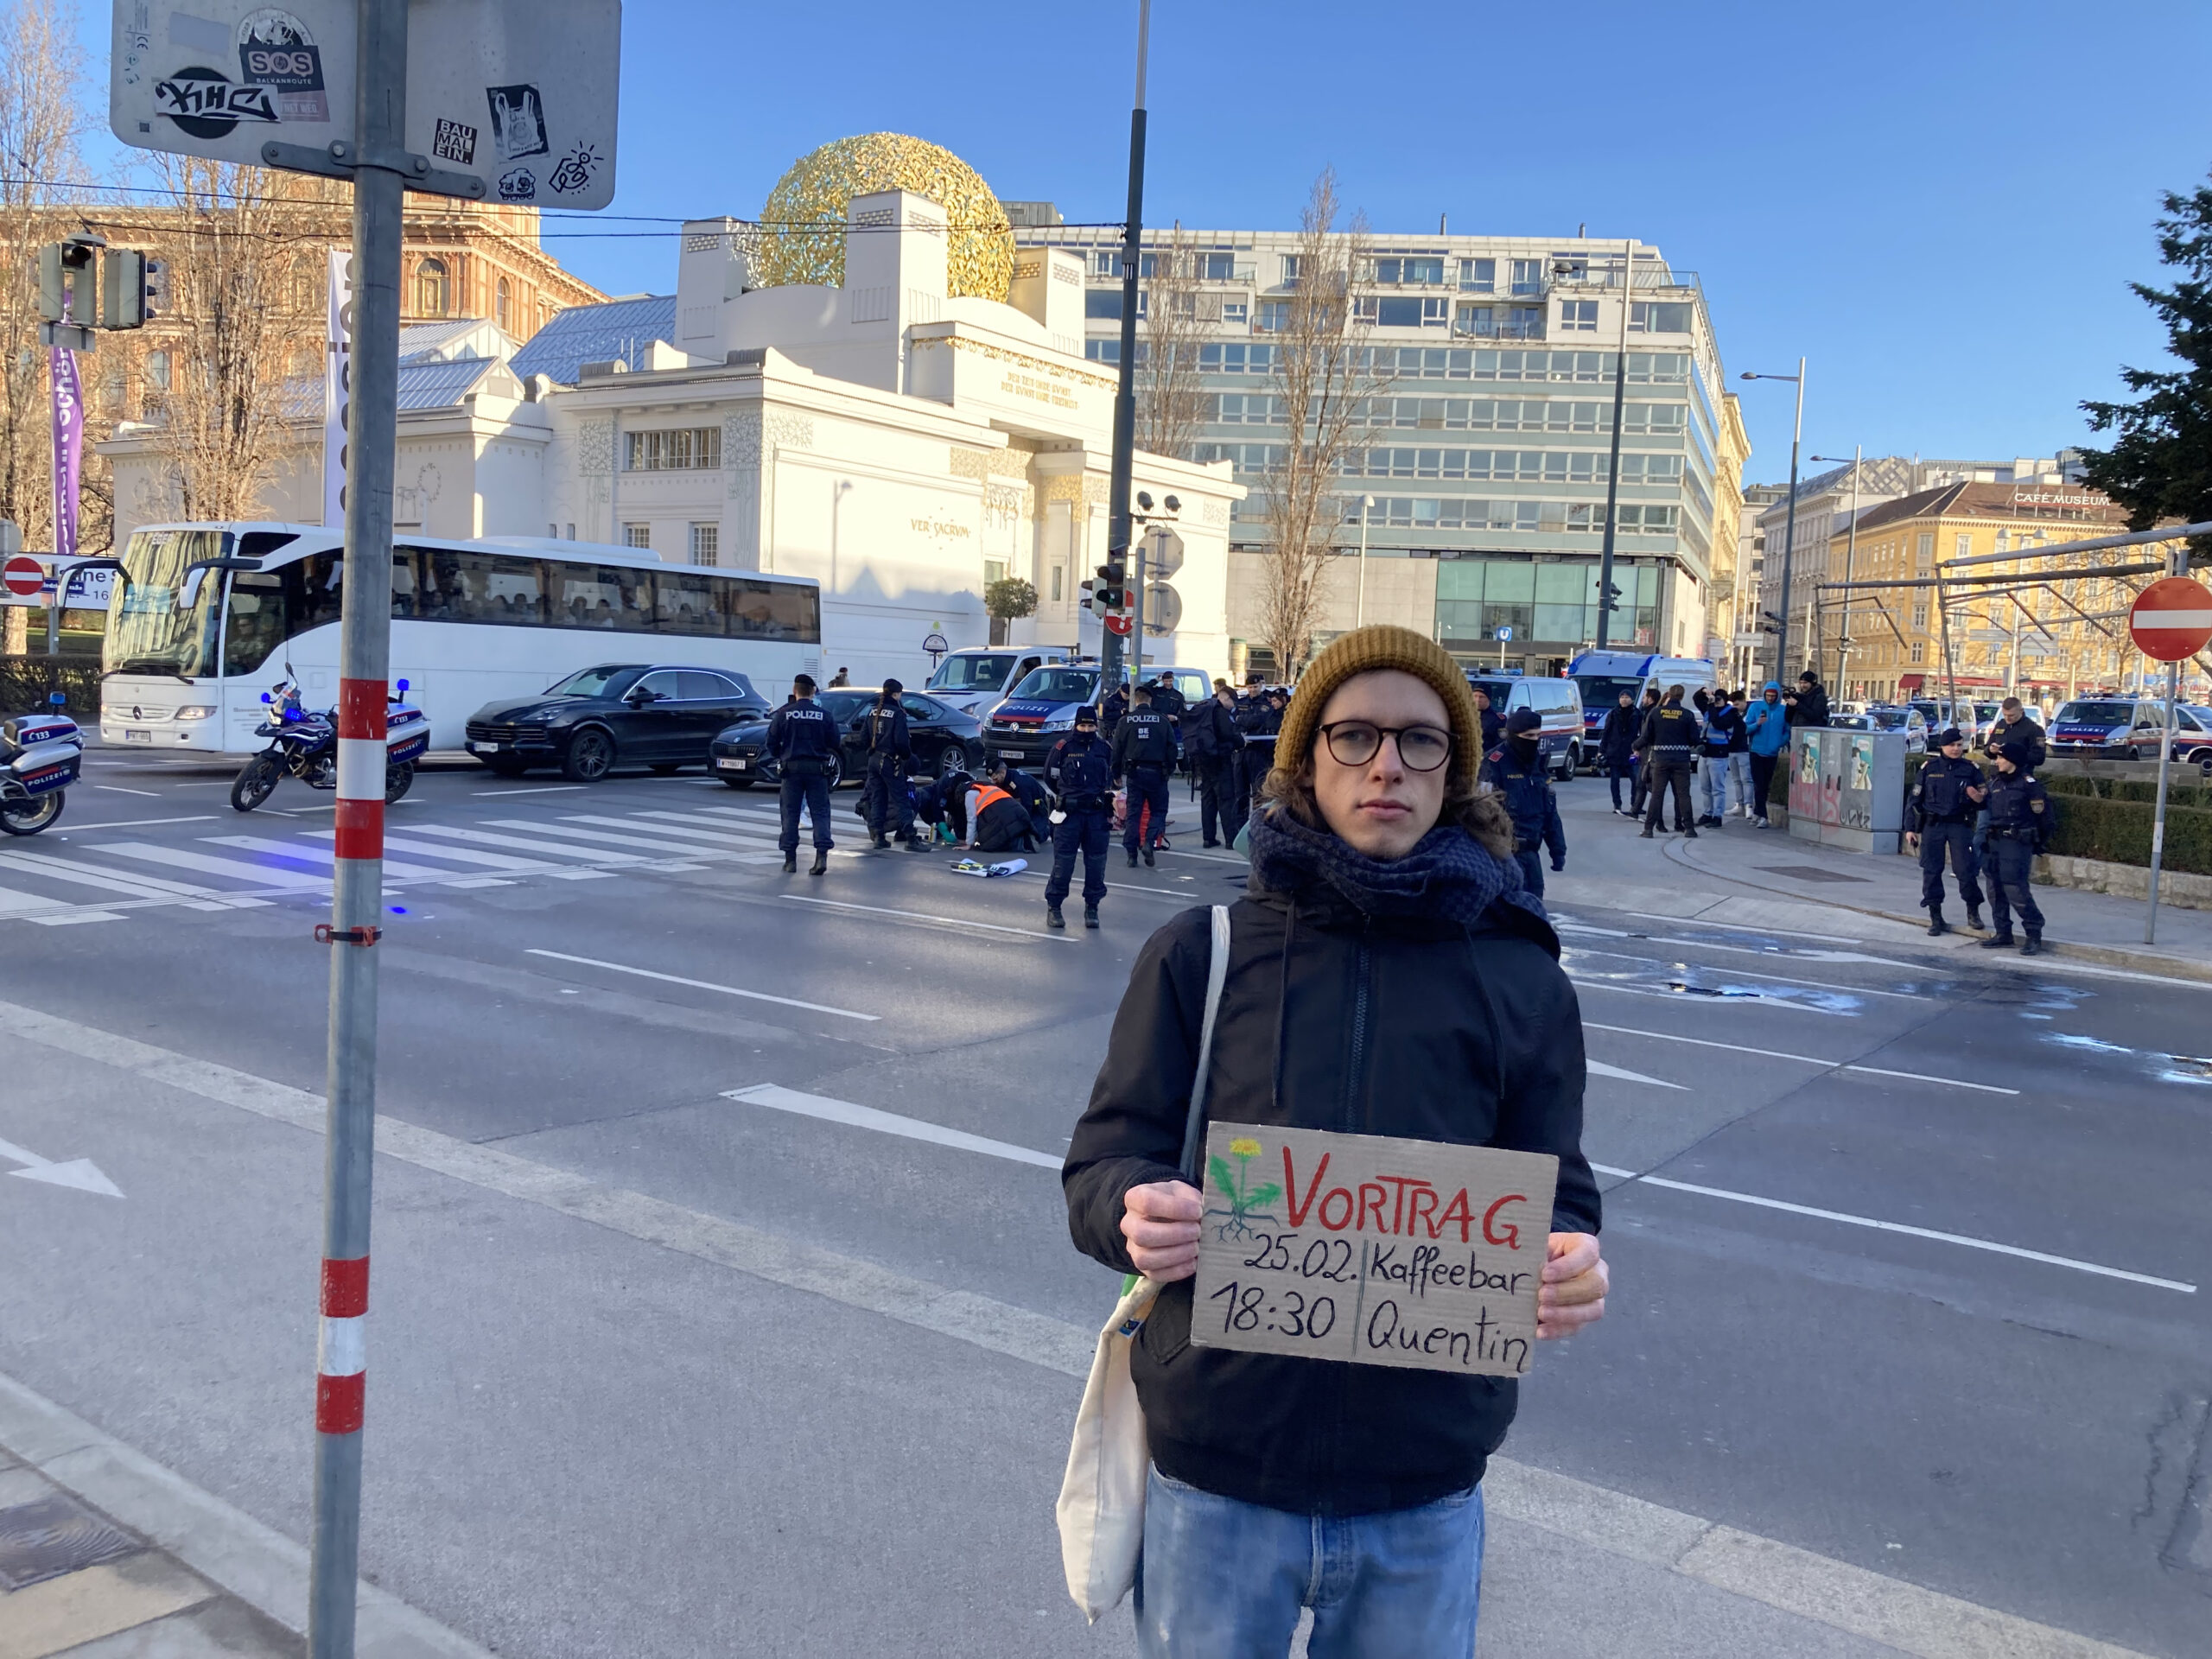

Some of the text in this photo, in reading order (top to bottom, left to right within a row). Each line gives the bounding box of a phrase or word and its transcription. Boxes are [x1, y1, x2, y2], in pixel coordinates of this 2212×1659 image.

[250, 51, 314, 75] SOS
[441, 120, 472, 139] BAU
[439, 133, 471, 151] MAL
[436, 145, 469, 163] EIN.
[2014, 492, 2111, 505] CAFÉ MUSEUM
[911, 518, 930, 532] VER
[93, 590, 109, 600] 16
[785, 710, 824, 721] POLIZEI
[35, 731, 50, 740] 133
[393, 742, 418, 755] POLIZEI
[28, 772, 62, 786] POLIZEI
[1282, 1146, 1528, 1250] VORTRAG
[1243, 1233, 1533, 1299] 25.02. Kaffeebar
[1210, 1281, 1528, 1374] 18:30 Quentin
